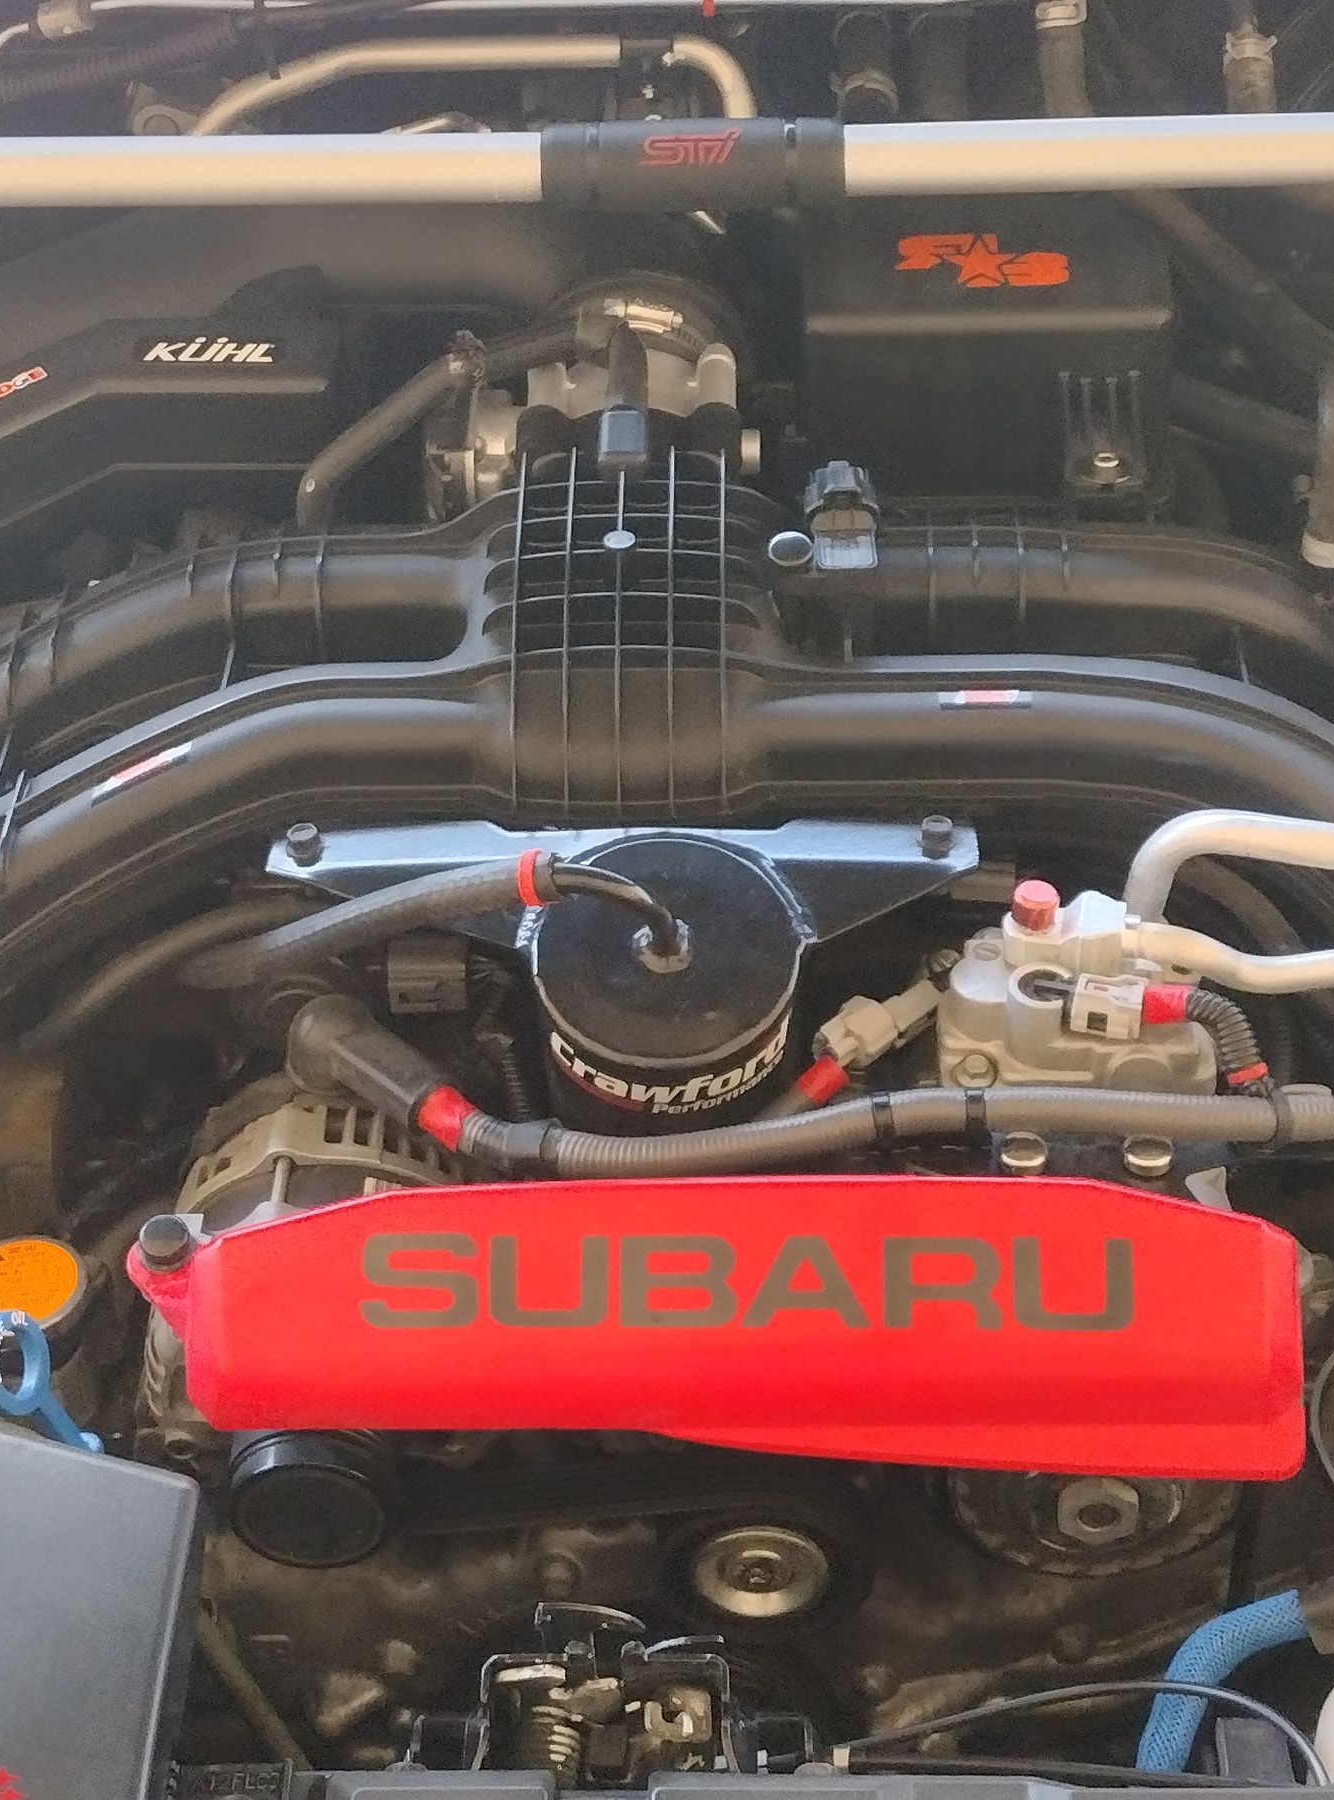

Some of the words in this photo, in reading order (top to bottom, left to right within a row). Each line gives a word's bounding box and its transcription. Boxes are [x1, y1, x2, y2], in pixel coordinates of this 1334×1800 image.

[143, 337, 273, 363] KÜHL
[550, 1012, 790, 1104] Crawford
[360, 1232, 1134, 1331] SUBARU
